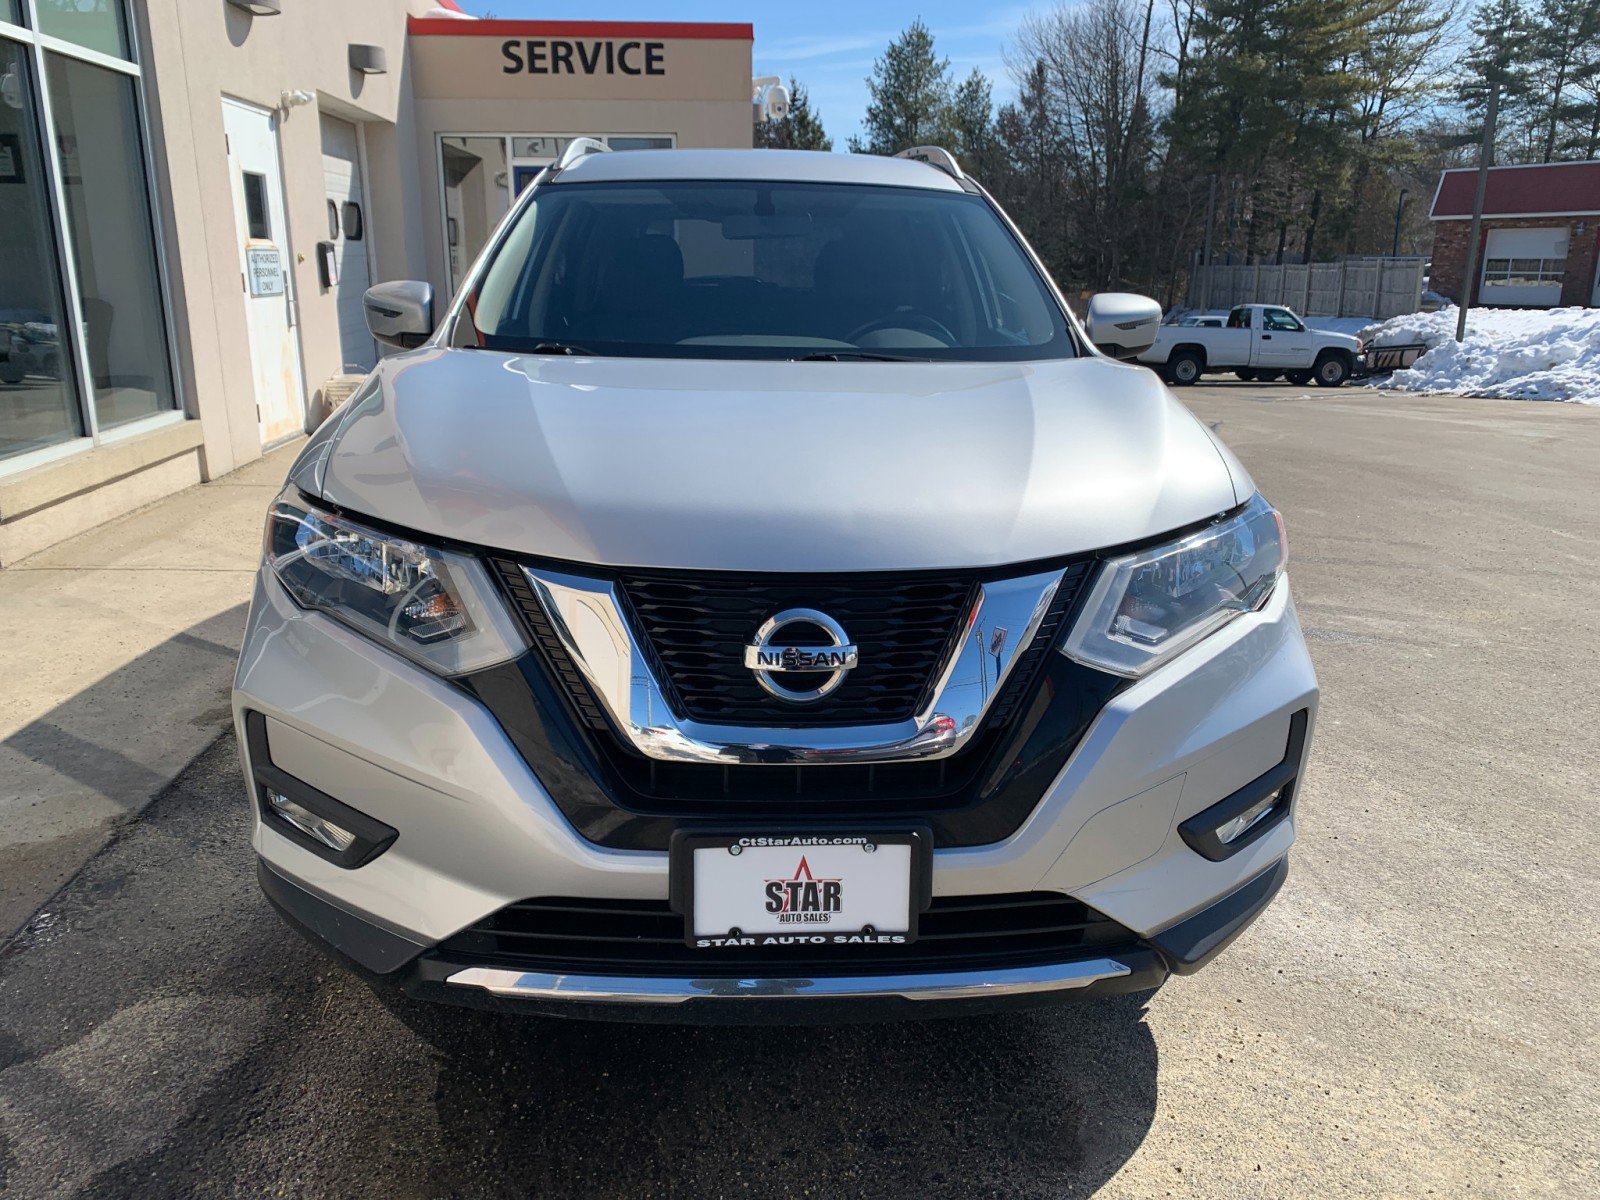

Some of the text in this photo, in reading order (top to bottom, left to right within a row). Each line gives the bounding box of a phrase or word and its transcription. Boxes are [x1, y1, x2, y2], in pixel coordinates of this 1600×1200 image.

[502, 40, 664, 75] SERVICE
[251, 252, 279, 263] AUTHORIZED
[253, 267, 280, 277] PERSONNEL
[262, 281, 274, 291] ONLY
[757, 652, 846, 666] NISSAN
[738, 837, 867, 847] CtStarAuto.com
[765, 881, 842, 913] STAR
[779, 913, 829, 923] AUTO SALES
[696, 934, 906, 948] STAR AUTO SALES
